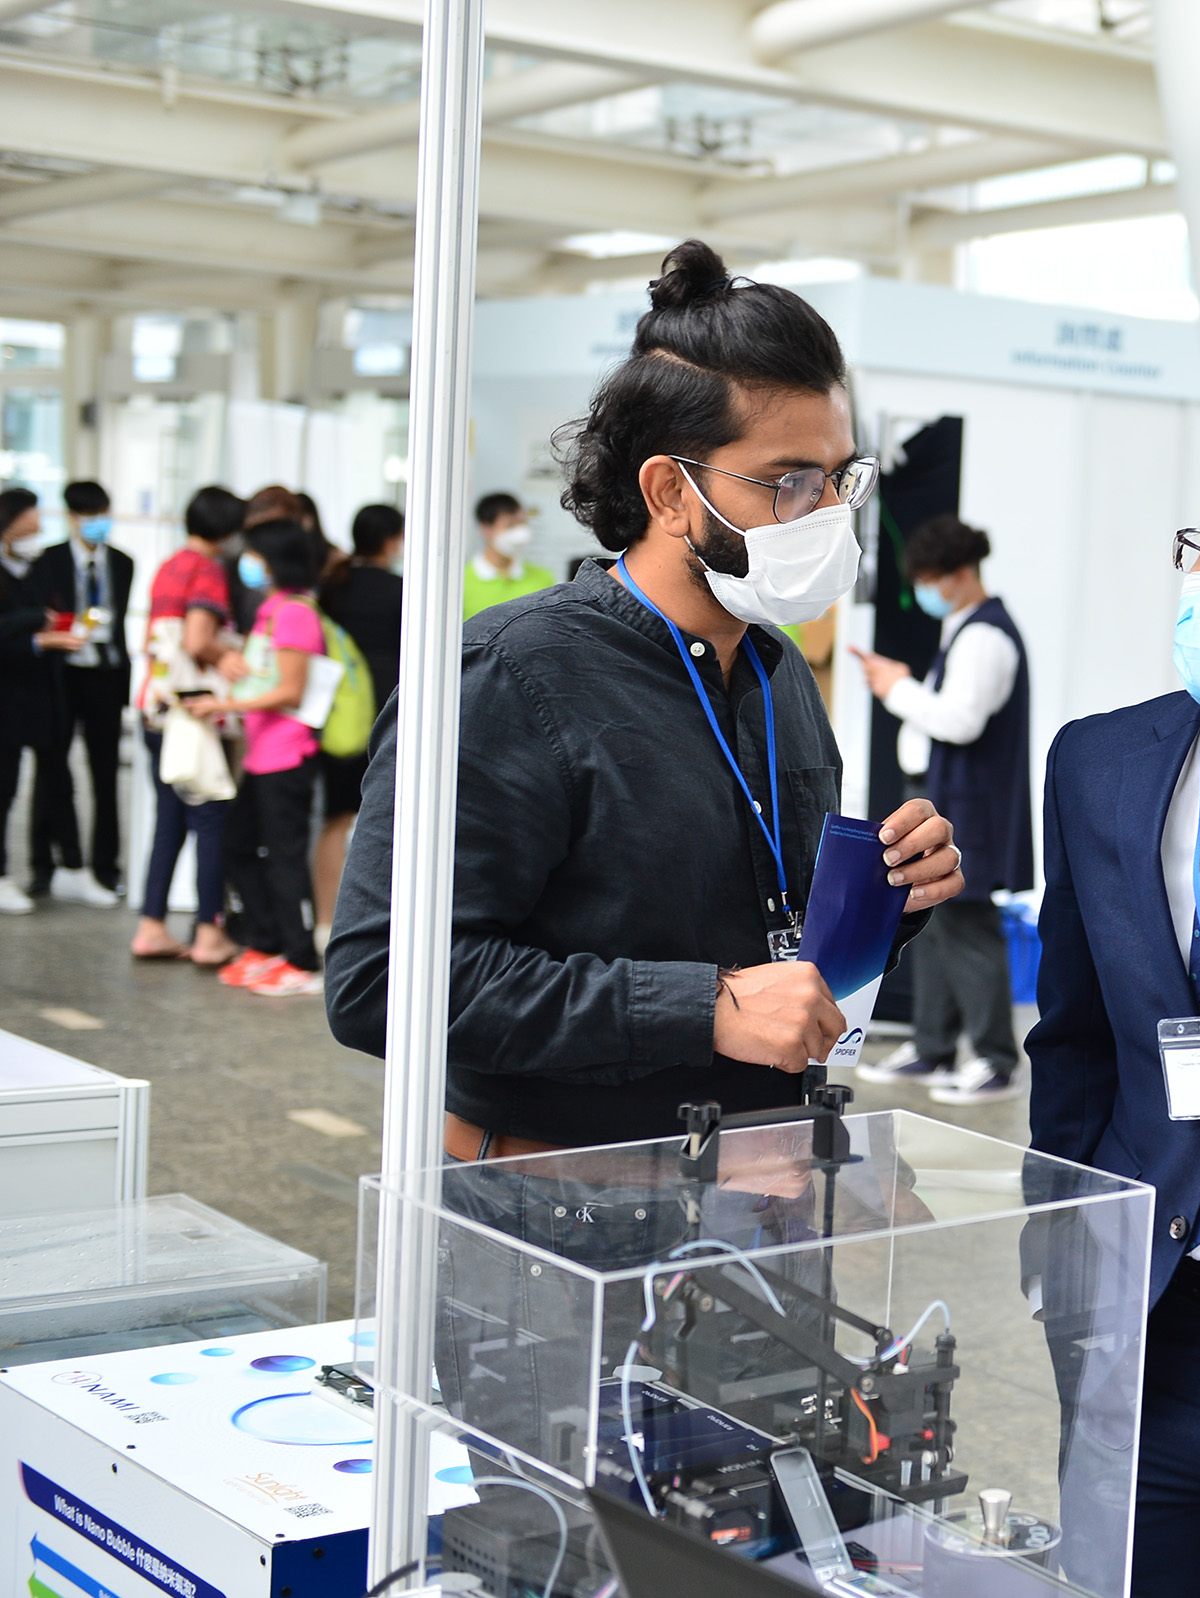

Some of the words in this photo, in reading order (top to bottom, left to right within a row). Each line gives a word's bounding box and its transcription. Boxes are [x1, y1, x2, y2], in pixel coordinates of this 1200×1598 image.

[54, 1494, 76, 1521] What
[75, 1508, 84, 1526] is
[84, 1514, 106, 1541] Nano
[106, 1529, 135, 1561] Bubble
